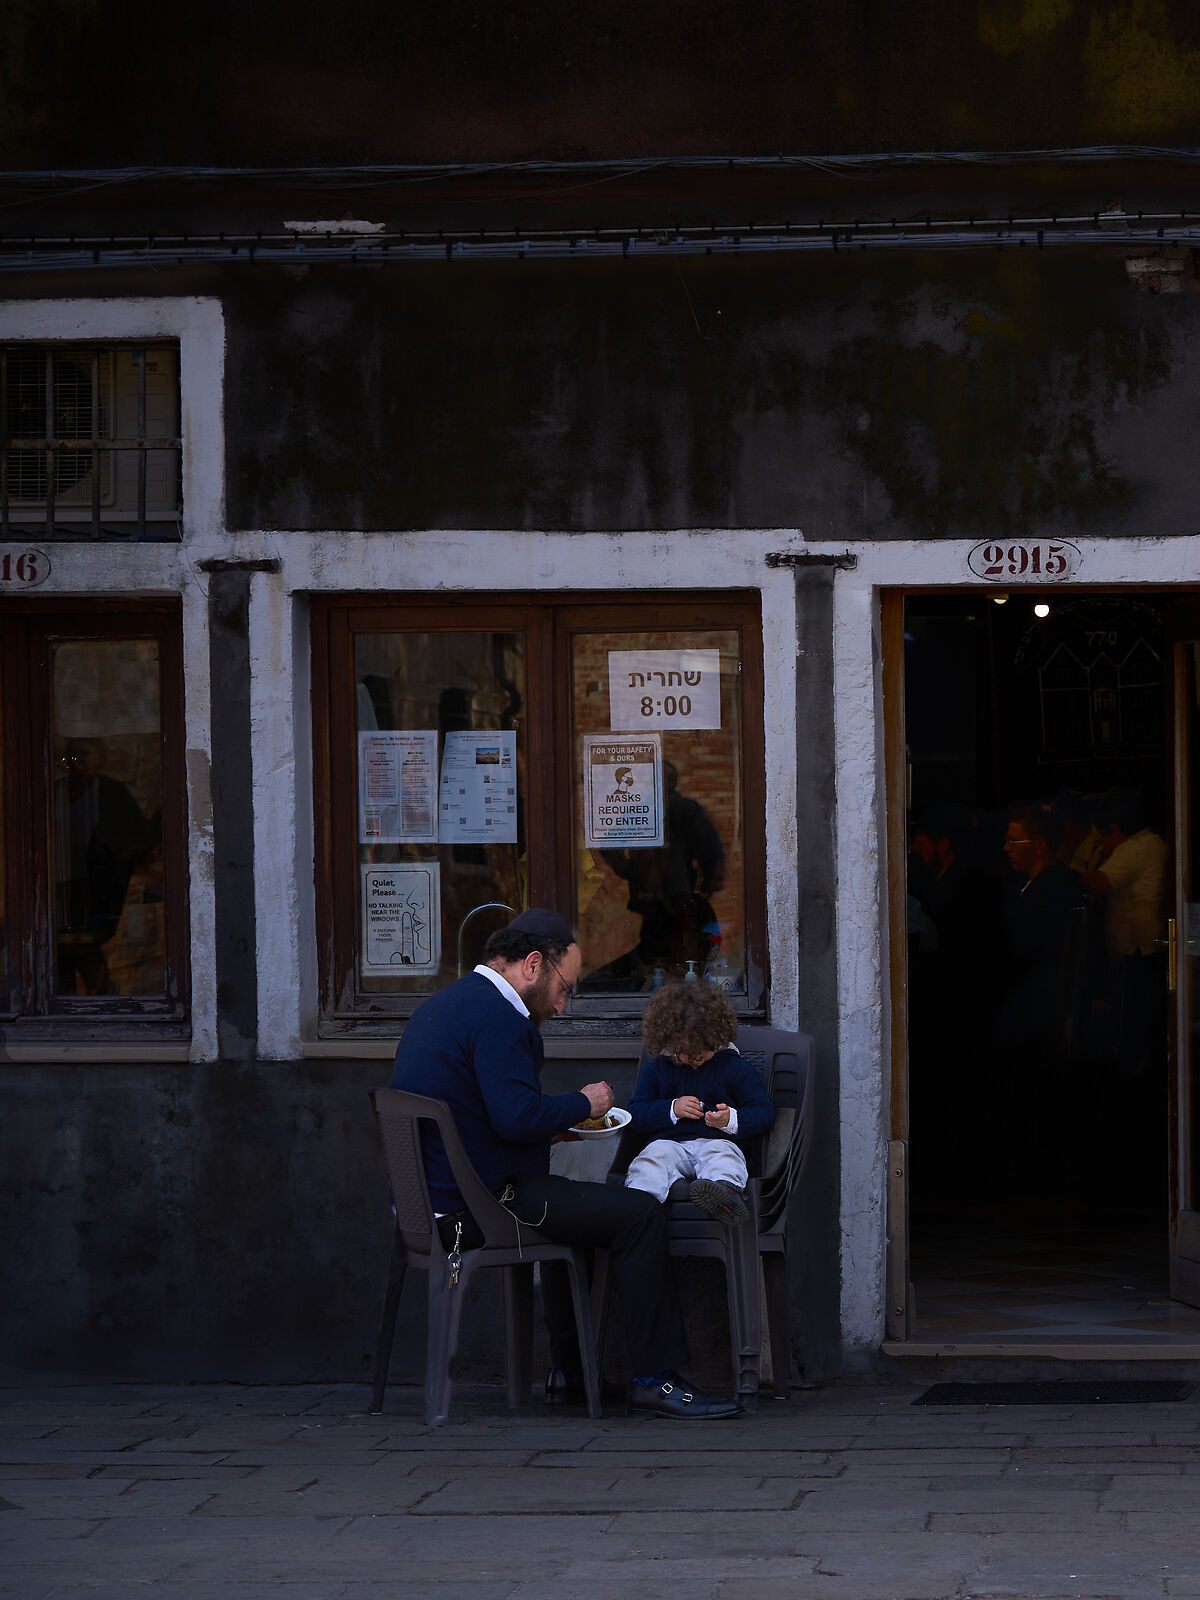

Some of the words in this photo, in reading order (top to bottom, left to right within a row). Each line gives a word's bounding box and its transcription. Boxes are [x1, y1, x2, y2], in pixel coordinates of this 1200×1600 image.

[983, 545, 1067, 575] 2915
[1084, 630, 1118, 647] 770
[628, 671, 702, 689] שחרית
[640, 695, 692, 717] 8:00
[626, 746, 652, 754] SAFETY
[606, 794, 641, 803] MASKS
[598, 805, 650, 815] REQUIRED
[600, 817, 613, 826] TO
[616, 816, 649, 826] ENTER
[372, 879, 395, 887] Quiet,
